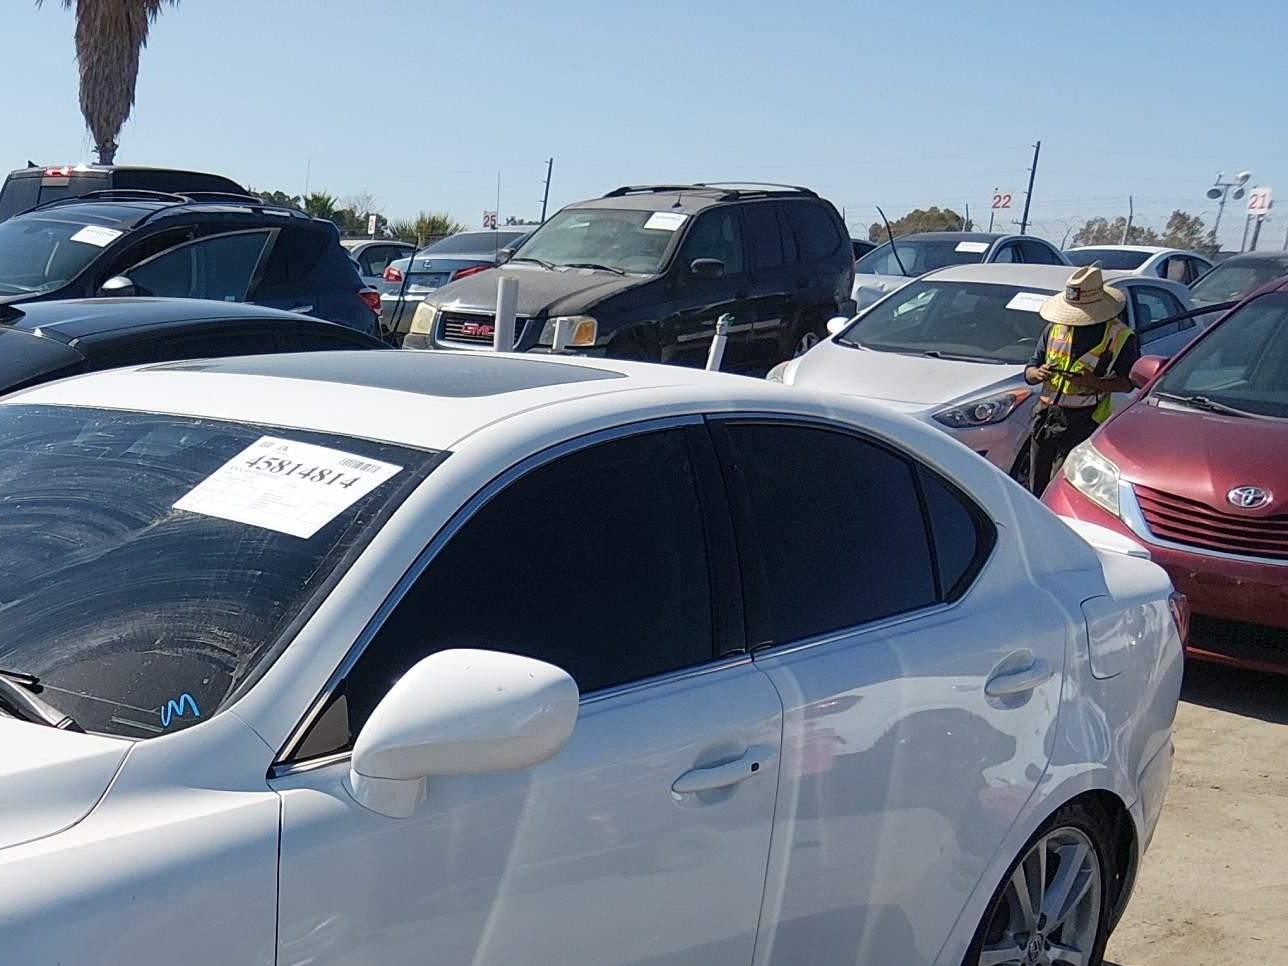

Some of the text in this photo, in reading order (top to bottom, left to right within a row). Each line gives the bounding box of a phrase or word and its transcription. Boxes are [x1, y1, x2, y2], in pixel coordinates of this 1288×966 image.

[992, 194, 1012, 209] 22
[1247, 193, 1267, 210] 21
[244, 454, 362, 490] 45814814
